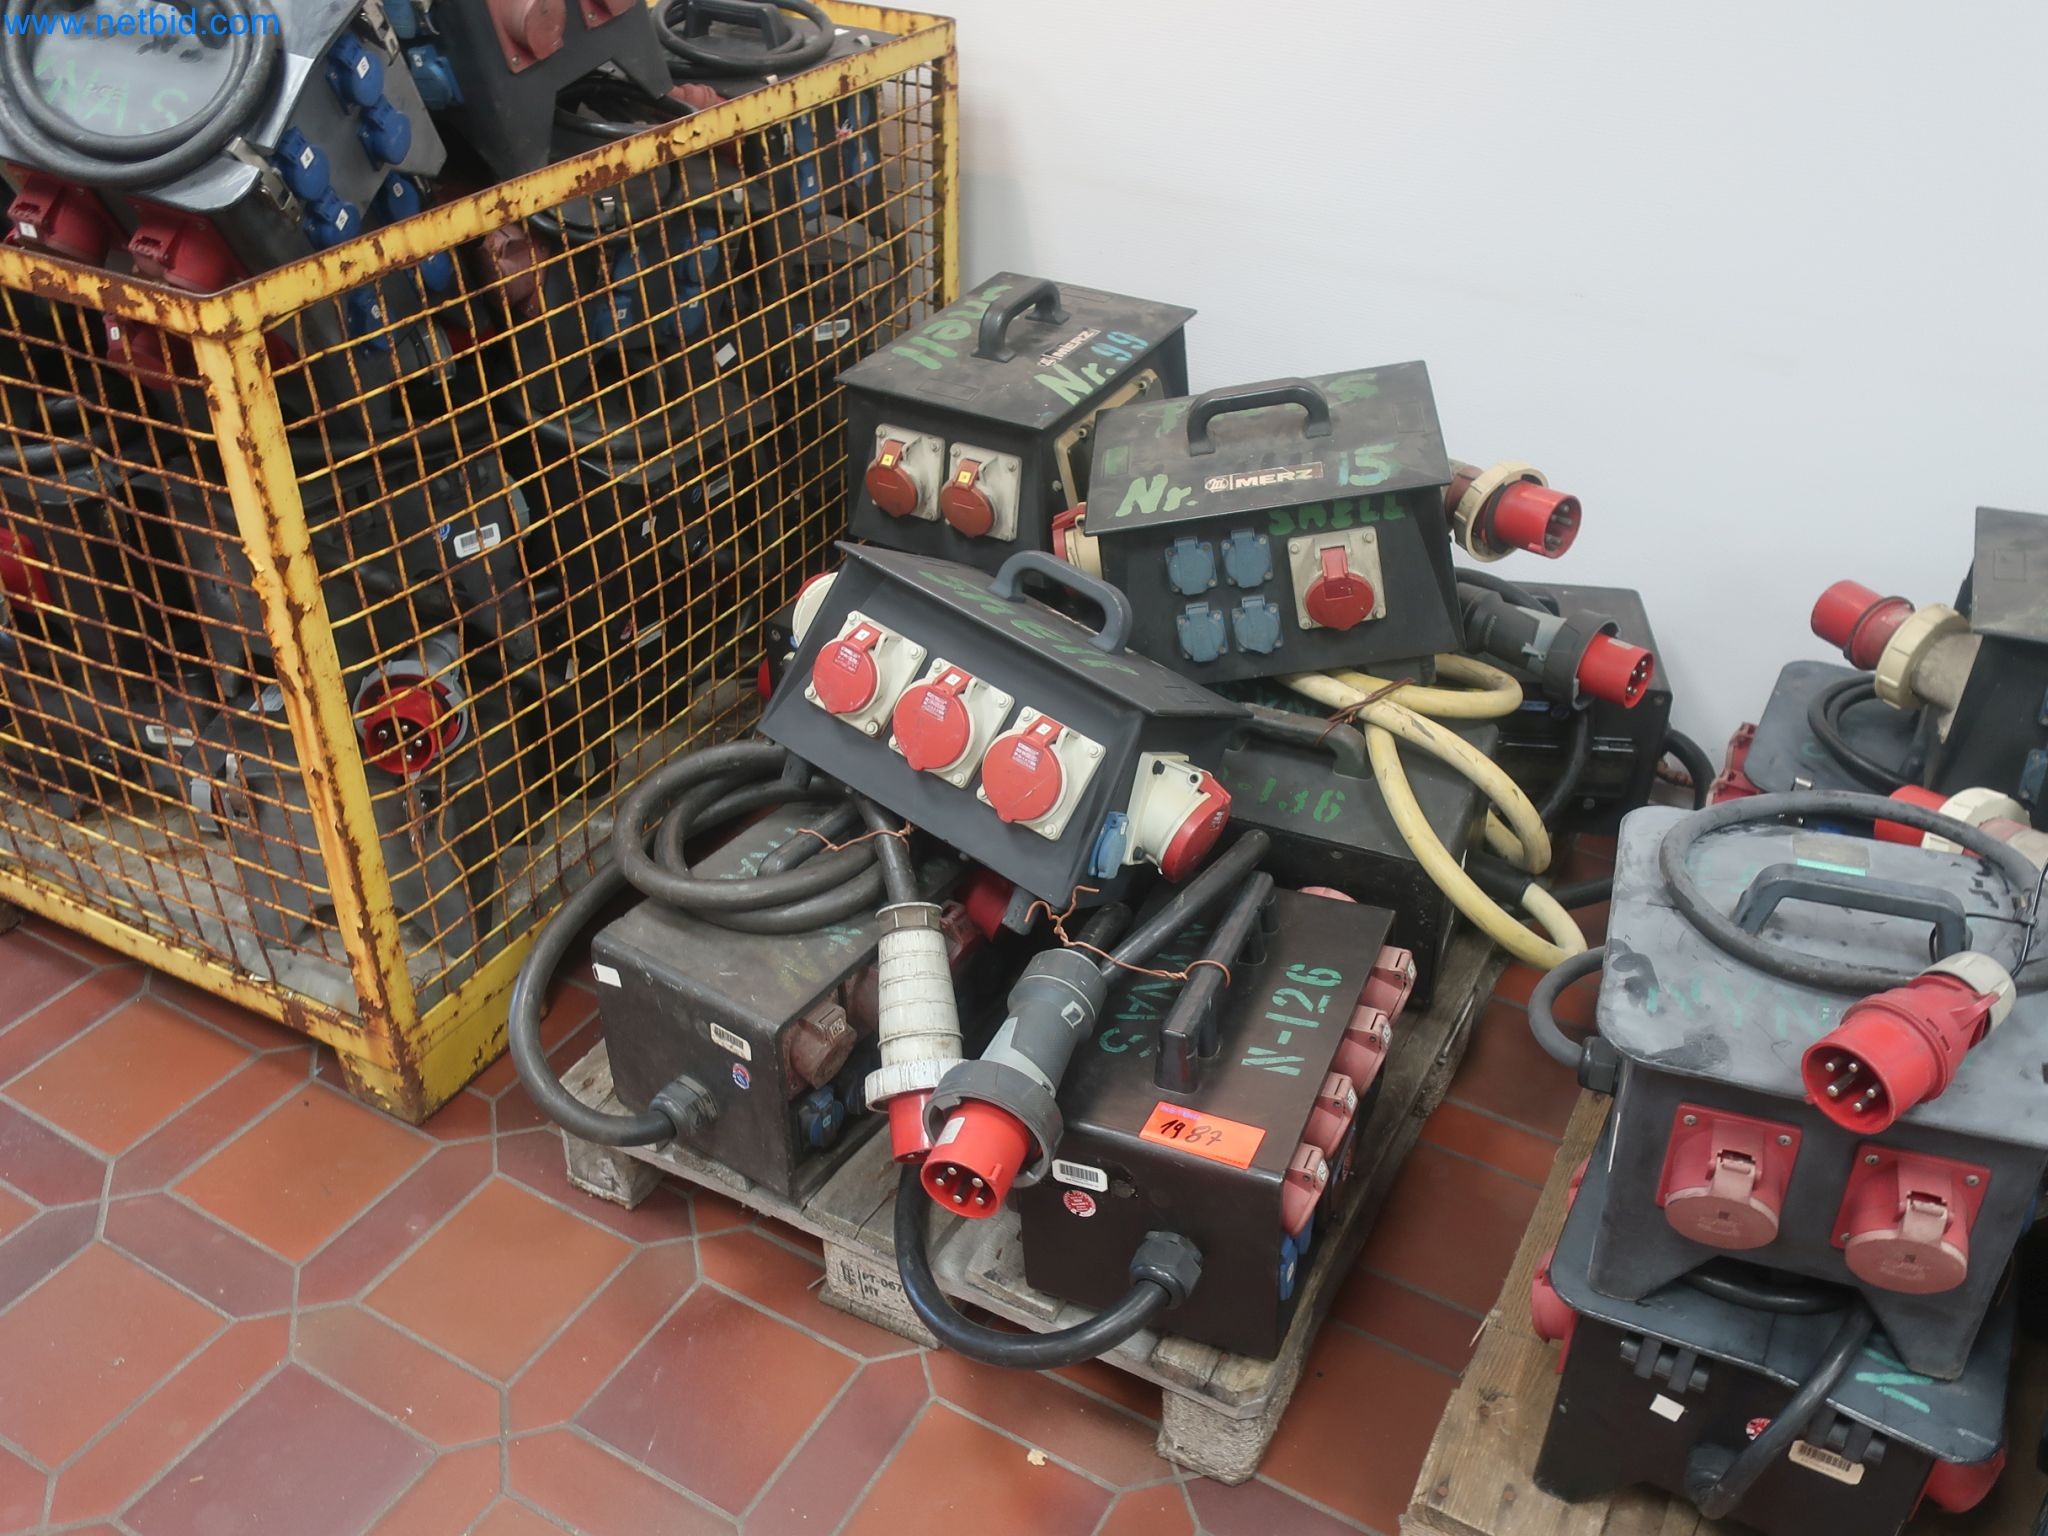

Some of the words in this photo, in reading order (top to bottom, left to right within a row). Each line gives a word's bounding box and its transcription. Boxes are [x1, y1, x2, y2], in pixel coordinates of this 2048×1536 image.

[1034, 363, 1116, 406] Nr.
[1114, 473, 1199, 518] Nr.
[1337, 441, 1401, 488] 15
[1235, 467, 1313, 489] MERZ
[1241, 963, 1343, 1077] N-126
